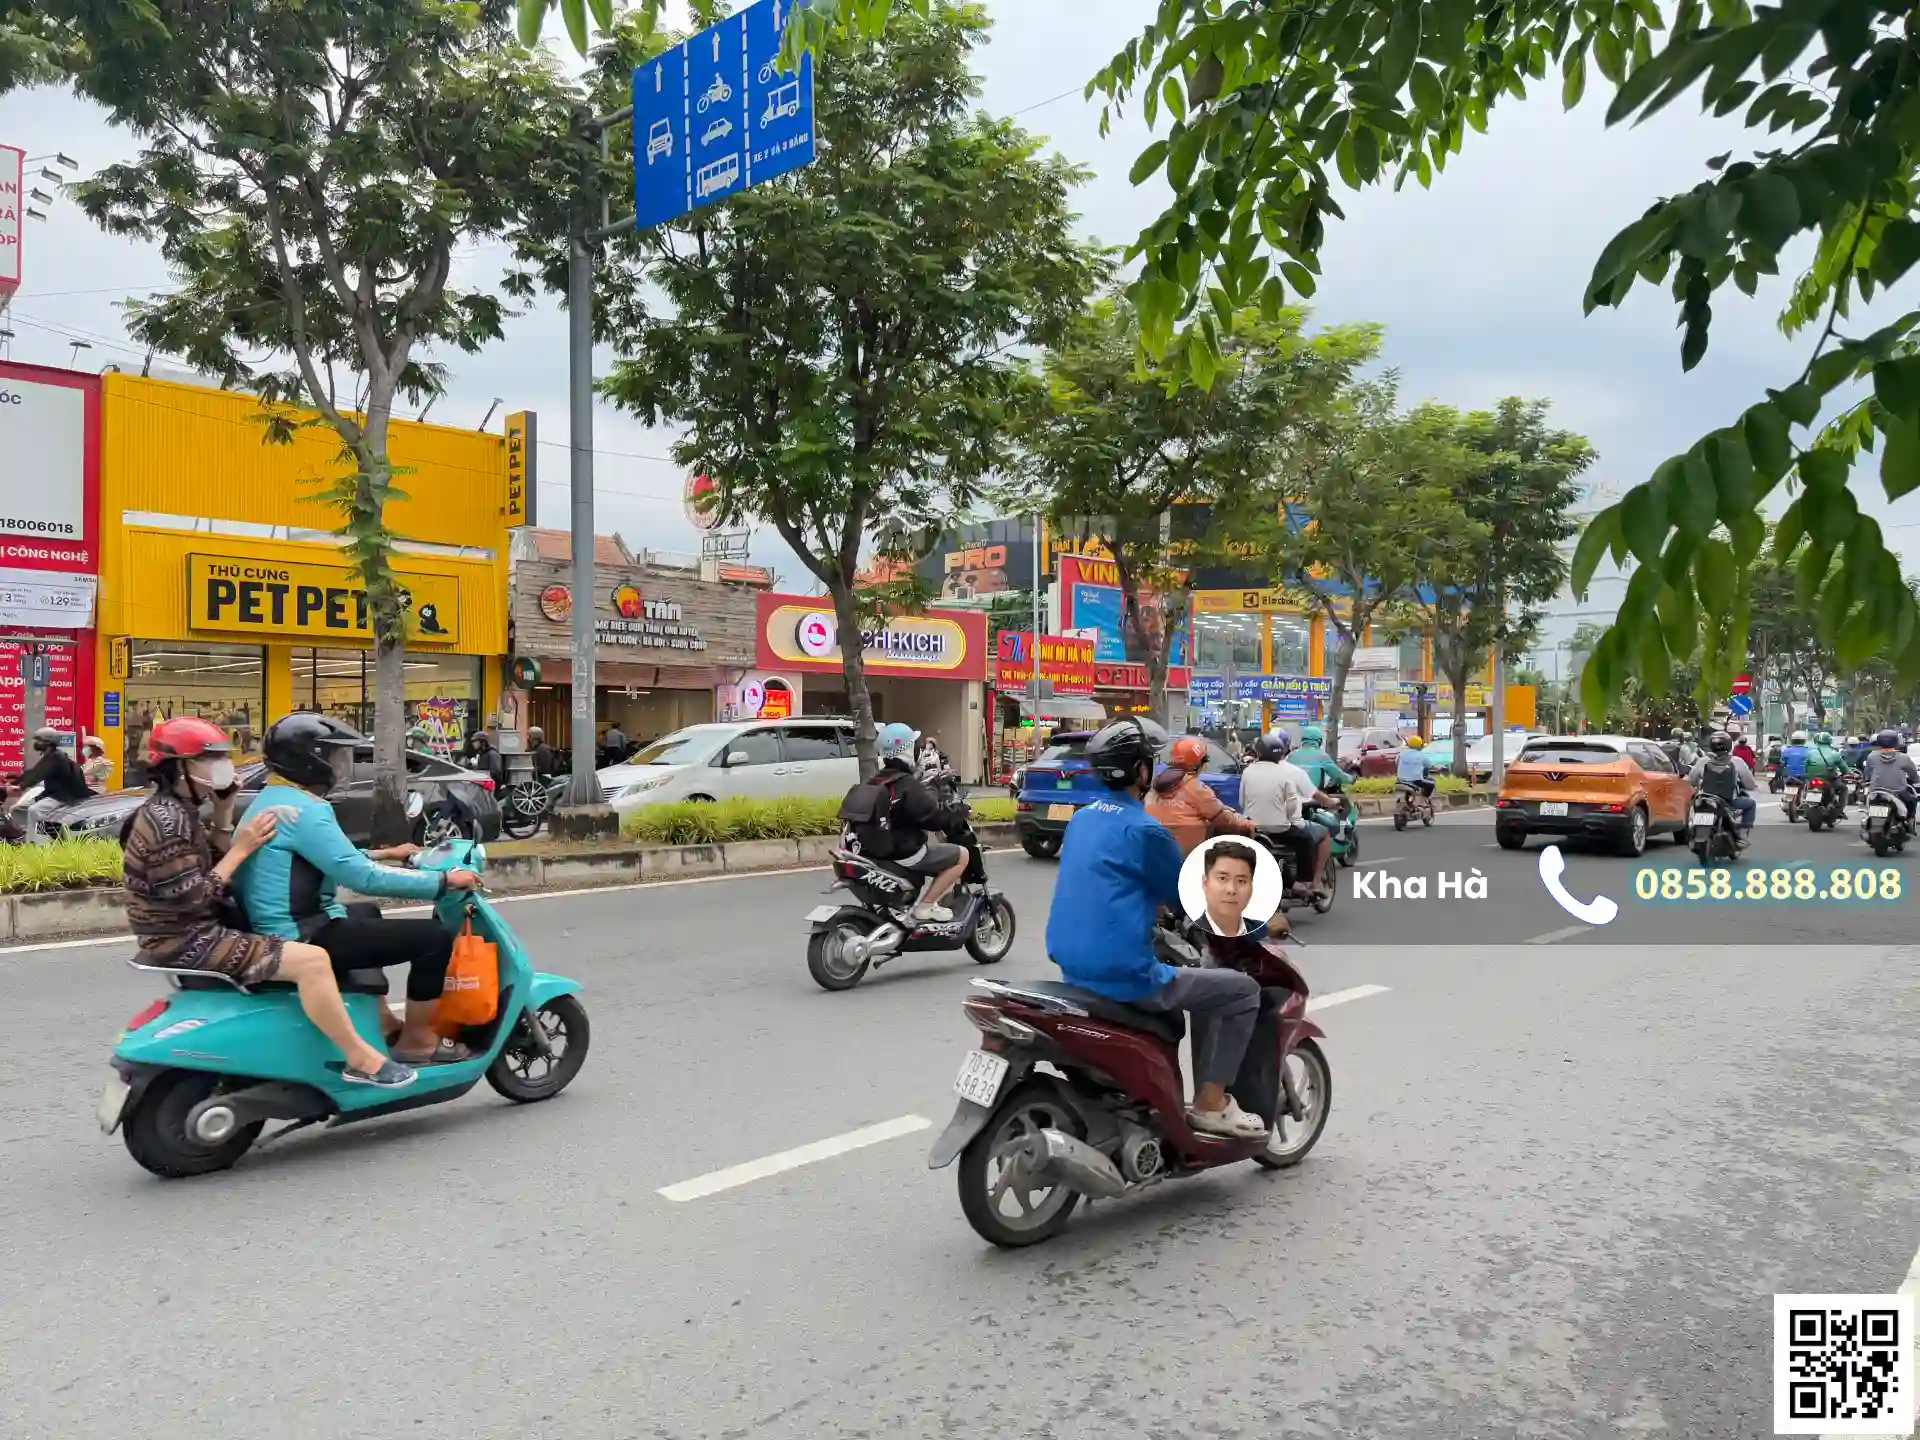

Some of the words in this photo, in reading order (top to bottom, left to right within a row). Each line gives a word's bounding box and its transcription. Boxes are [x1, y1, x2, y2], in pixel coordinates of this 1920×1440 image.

[509, 427, 522, 471] PET
[509, 473, 522, 516] PET
[0, 518, 74, 534] 18006018
[7, 545, 48, 560] CÔNG
[51, 549, 89, 564] NGHỆ
[945, 545, 1006, 574] PRO
[244, 567, 290, 581] CƯNG
[207, 579, 290, 624] PET
[297, 586, 368, 630] PET
[860, 869, 900, 893] RACE
